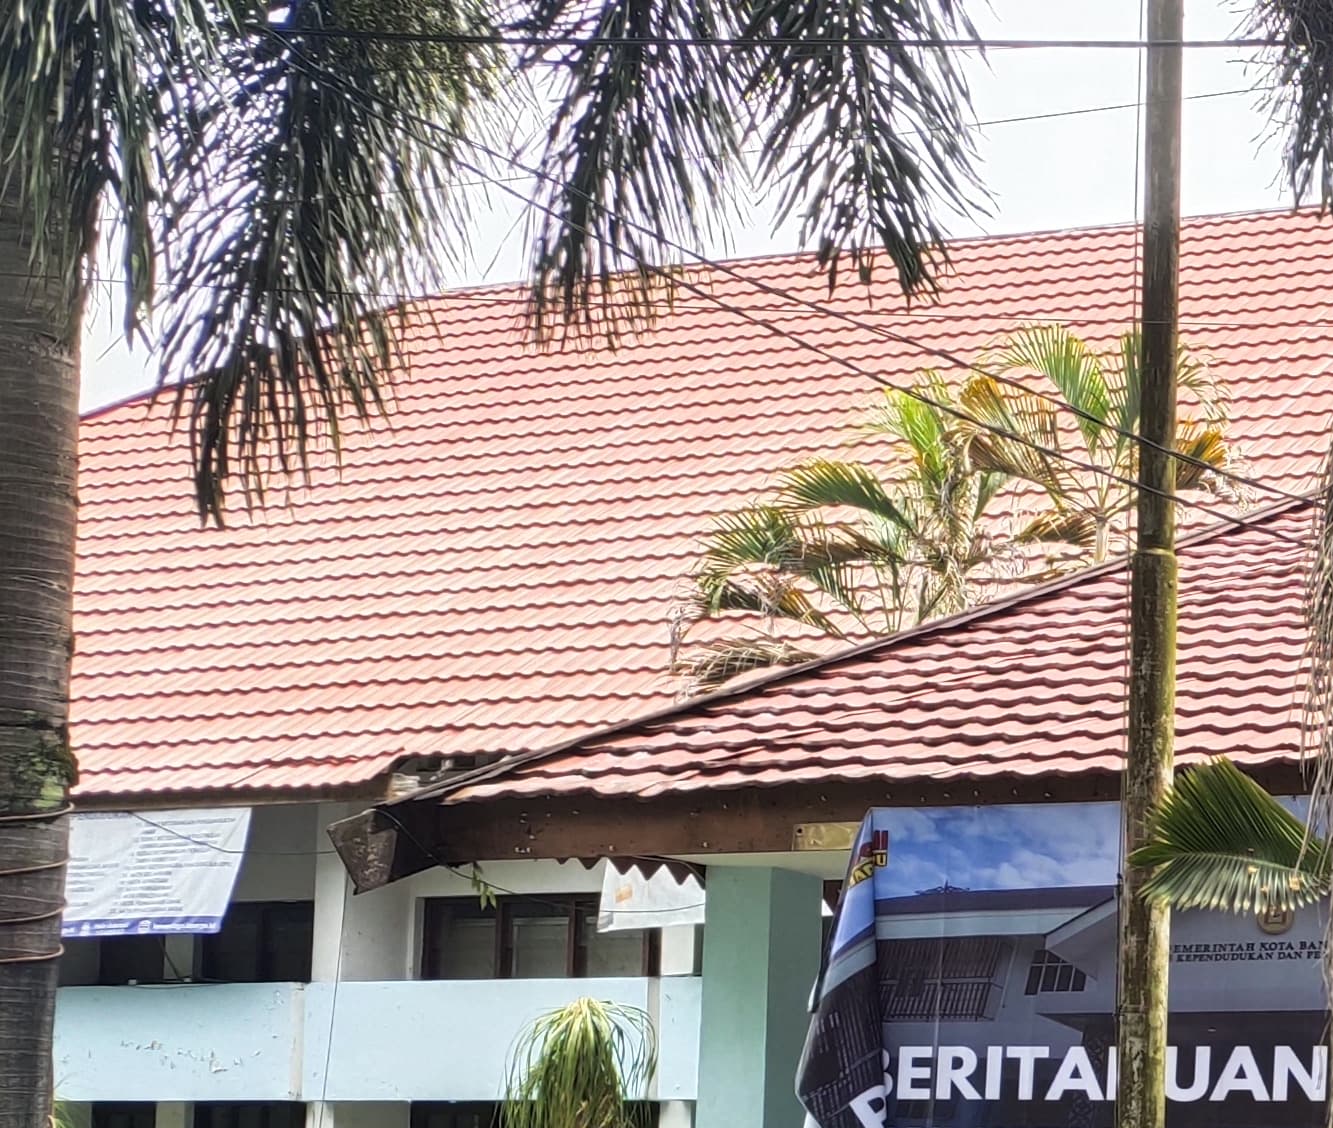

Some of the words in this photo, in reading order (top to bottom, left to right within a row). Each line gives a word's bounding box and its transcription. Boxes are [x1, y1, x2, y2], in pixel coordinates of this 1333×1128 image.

[1169, 942, 1255, 953] EMERINTAH
[1260, 941, 1298, 951] KOTA
[1176, 950, 1273, 962] KEPENDUDUKAN
[1278, 950, 1304, 960] DAN
[882, 1046, 1329, 1102] ERITAUAN
